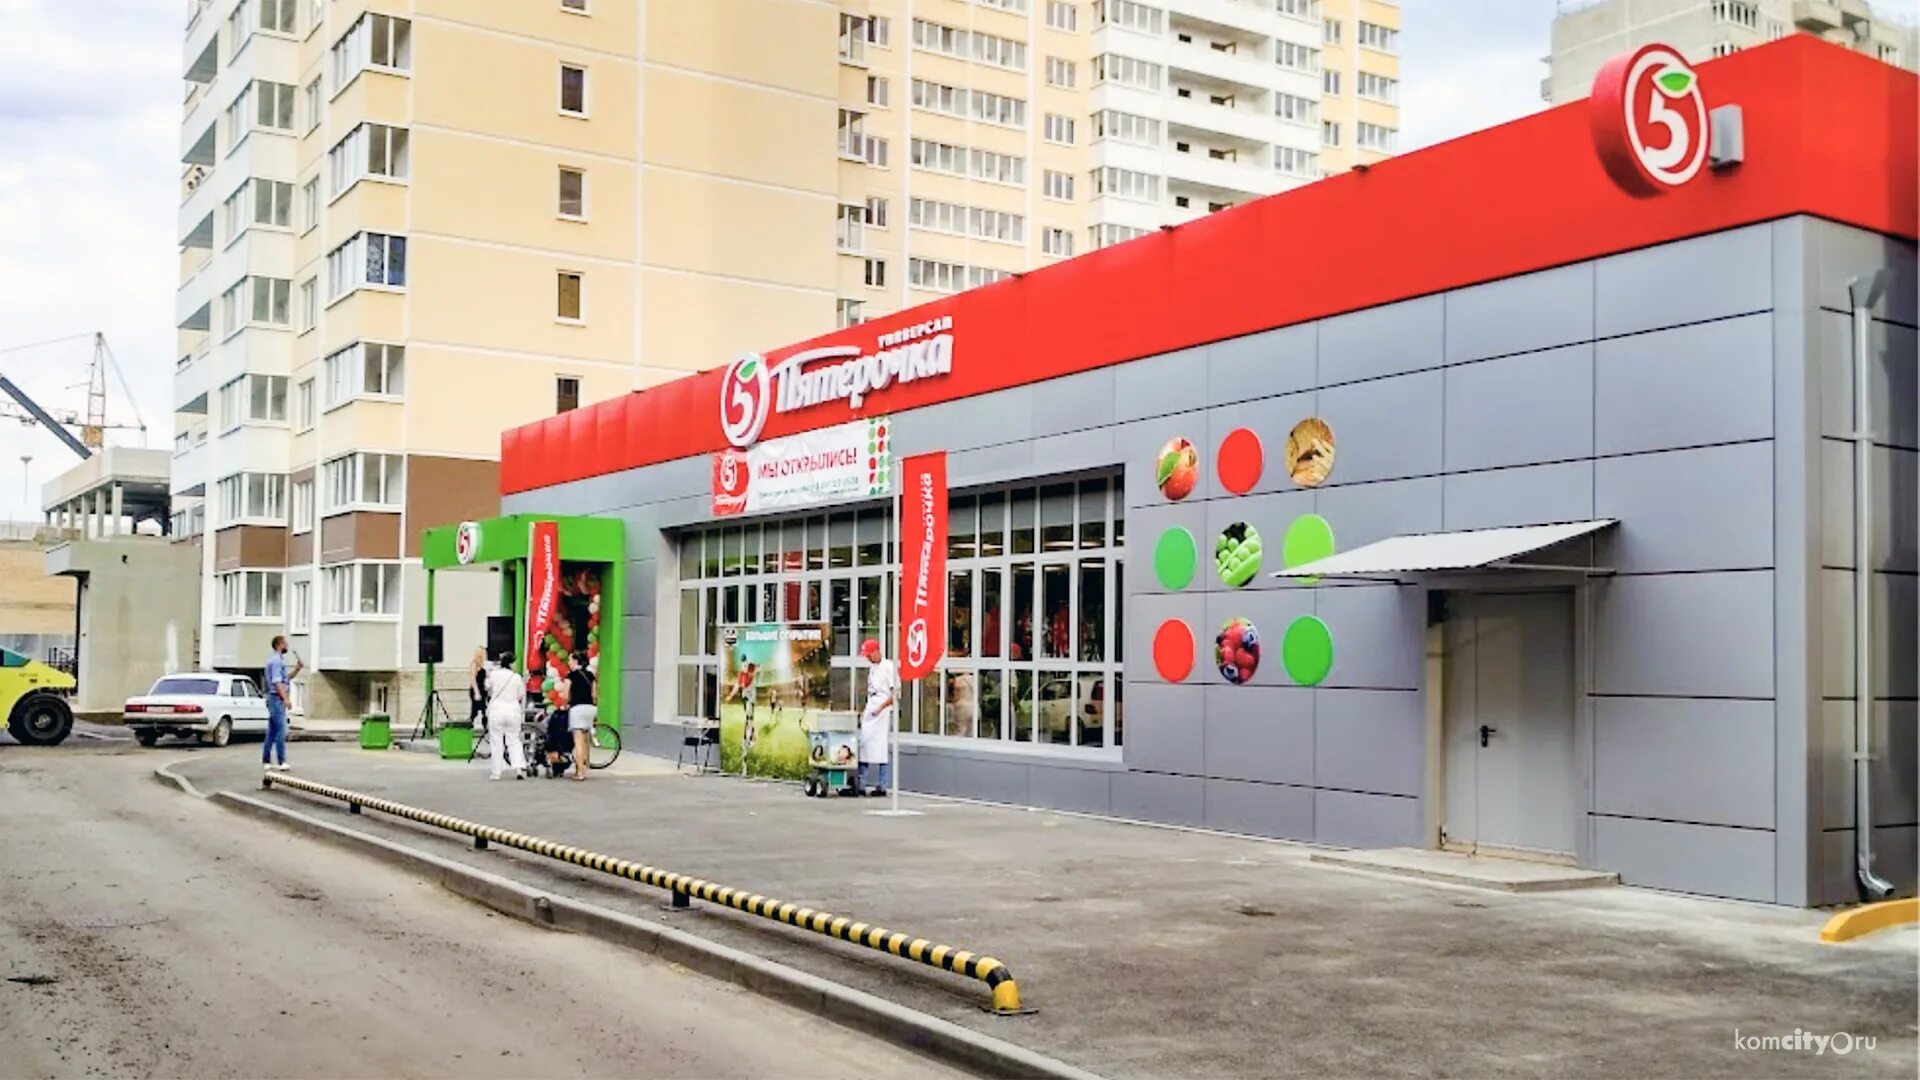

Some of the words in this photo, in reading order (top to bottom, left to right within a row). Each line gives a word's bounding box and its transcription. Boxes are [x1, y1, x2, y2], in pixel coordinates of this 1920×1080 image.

[769, 333, 954, 412] Пятерочка
[758, 461, 779, 480] МЫ
[781, 447, 858, 476] ОТКРЫЛИСЬ!
[914, 472, 935, 614] Пятерочка
